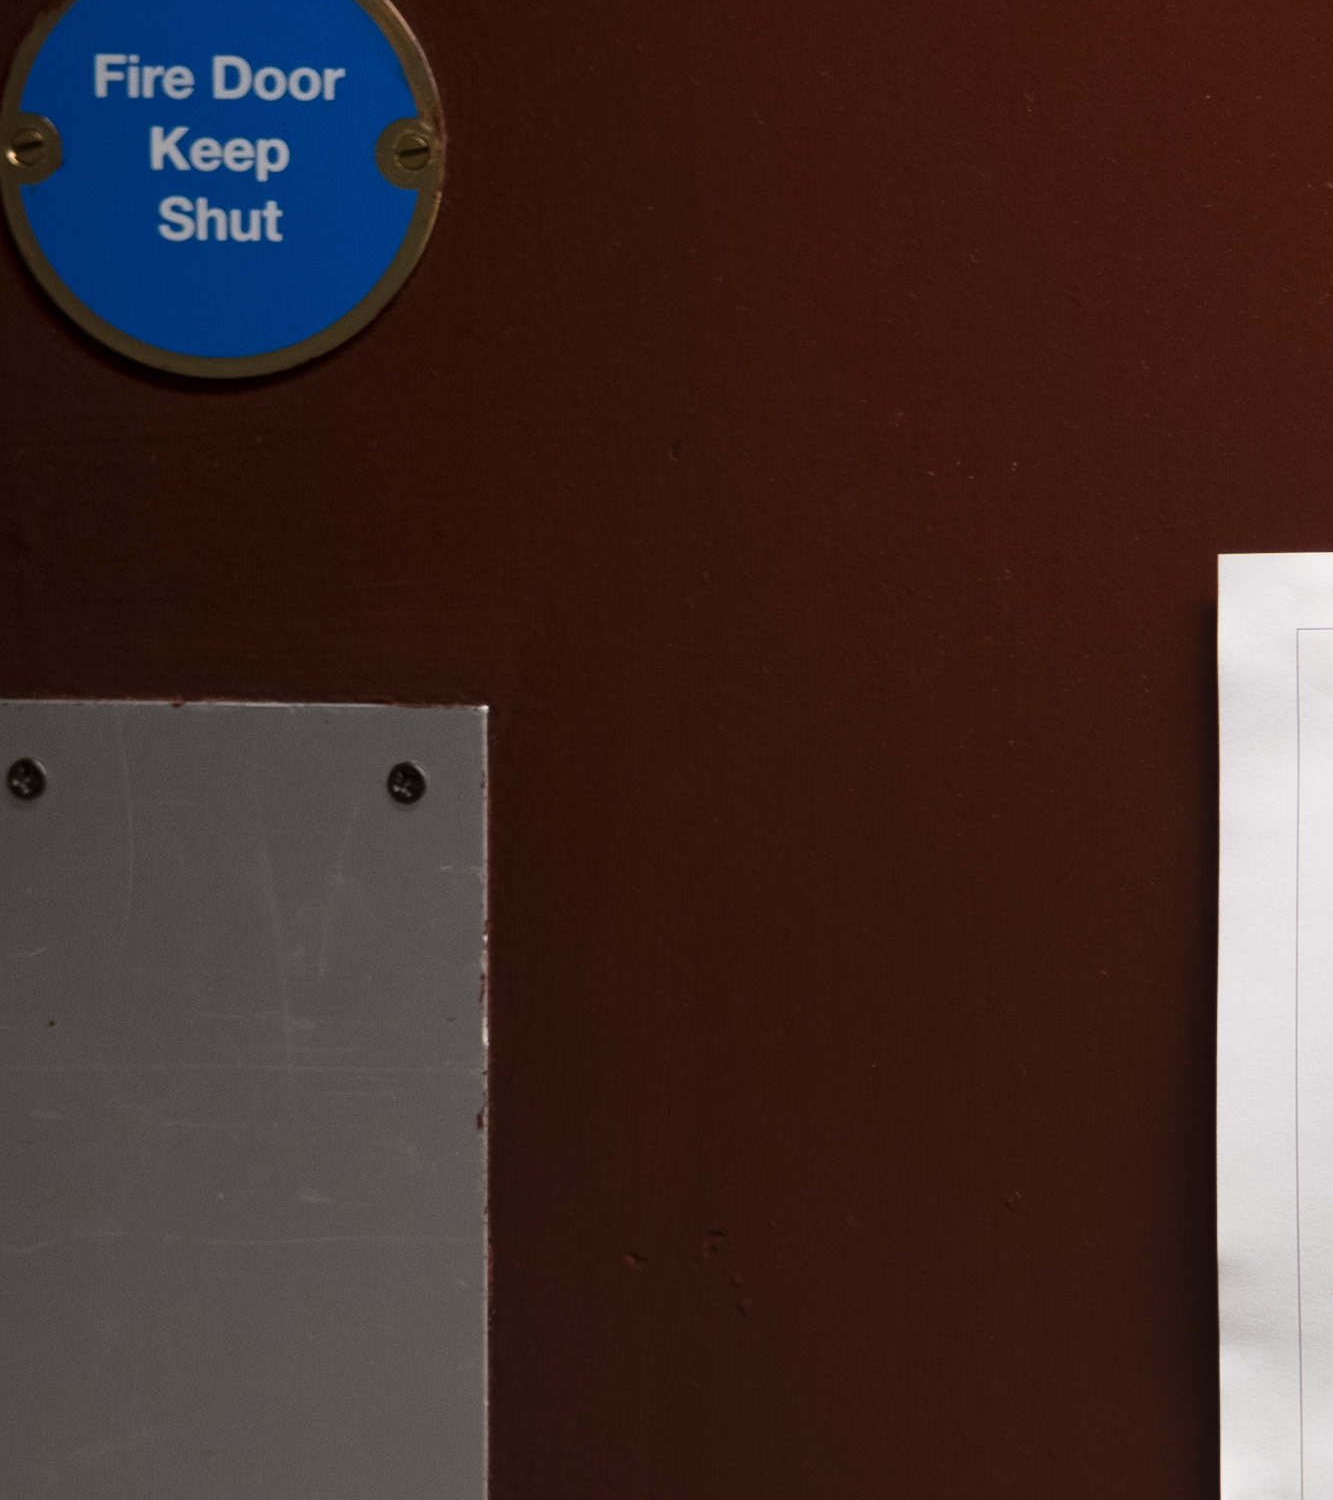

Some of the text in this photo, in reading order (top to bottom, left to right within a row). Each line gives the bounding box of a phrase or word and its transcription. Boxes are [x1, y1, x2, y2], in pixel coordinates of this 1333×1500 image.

[95, 54, 345, 101] Fire Door
[151, 126, 289, 182] Keep
[159, 196, 283, 242] Shut
